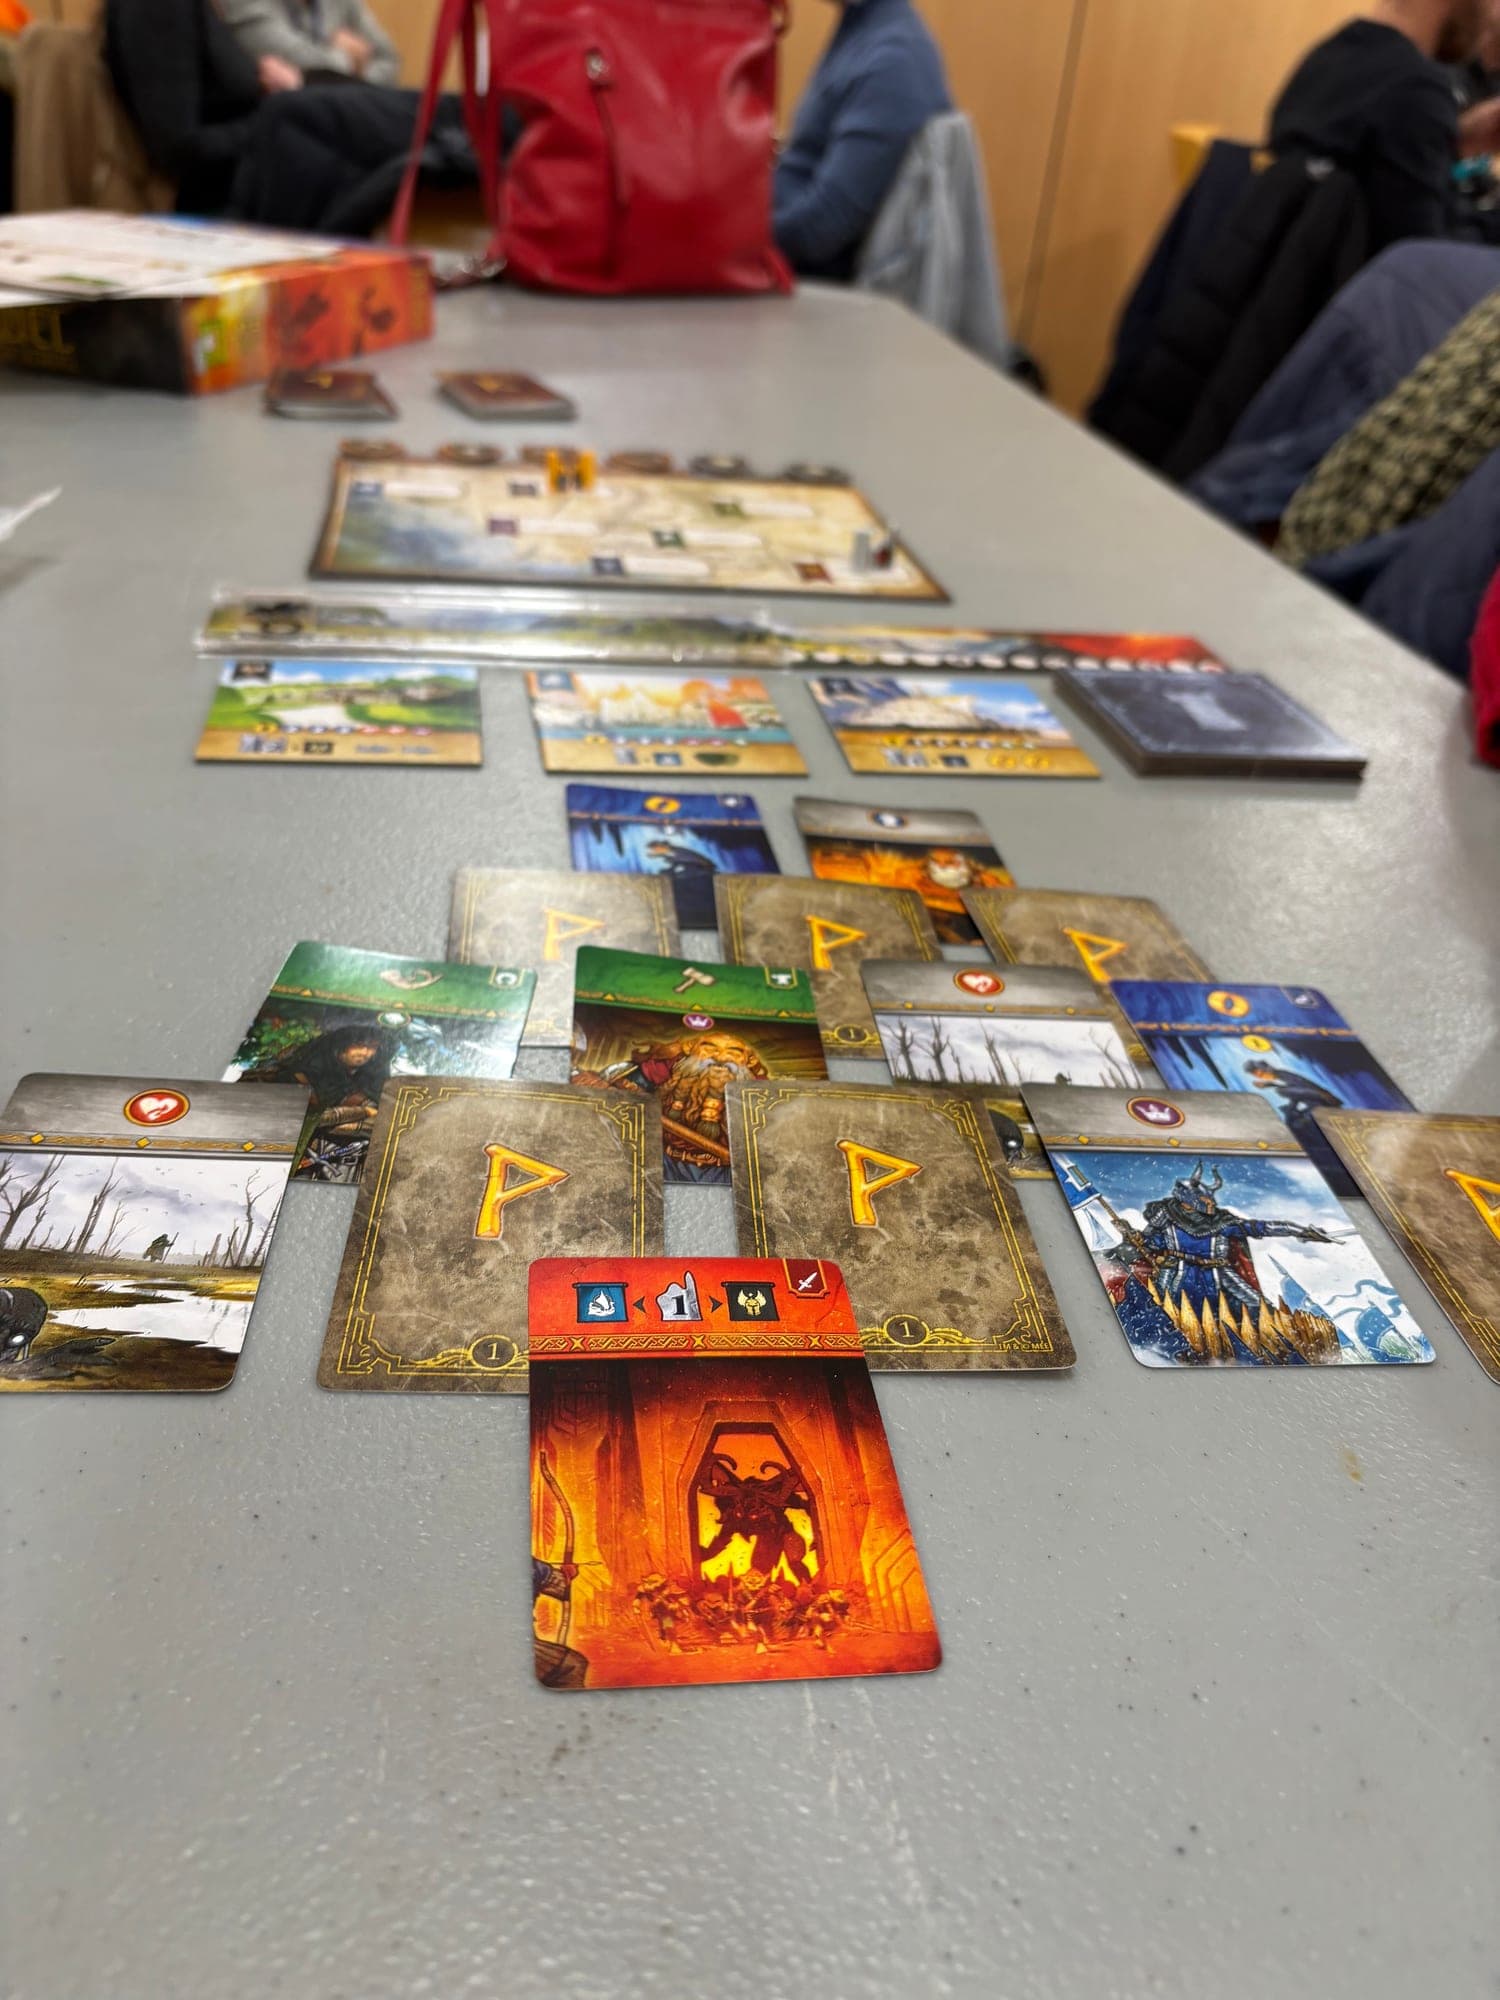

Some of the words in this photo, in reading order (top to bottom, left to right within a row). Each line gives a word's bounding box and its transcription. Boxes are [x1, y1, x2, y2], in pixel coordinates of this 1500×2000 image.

[672, 1294, 688, 1316] 1
[899, 1321, 915, 1338] 1
[487, 1342, 500, 1360] 1
